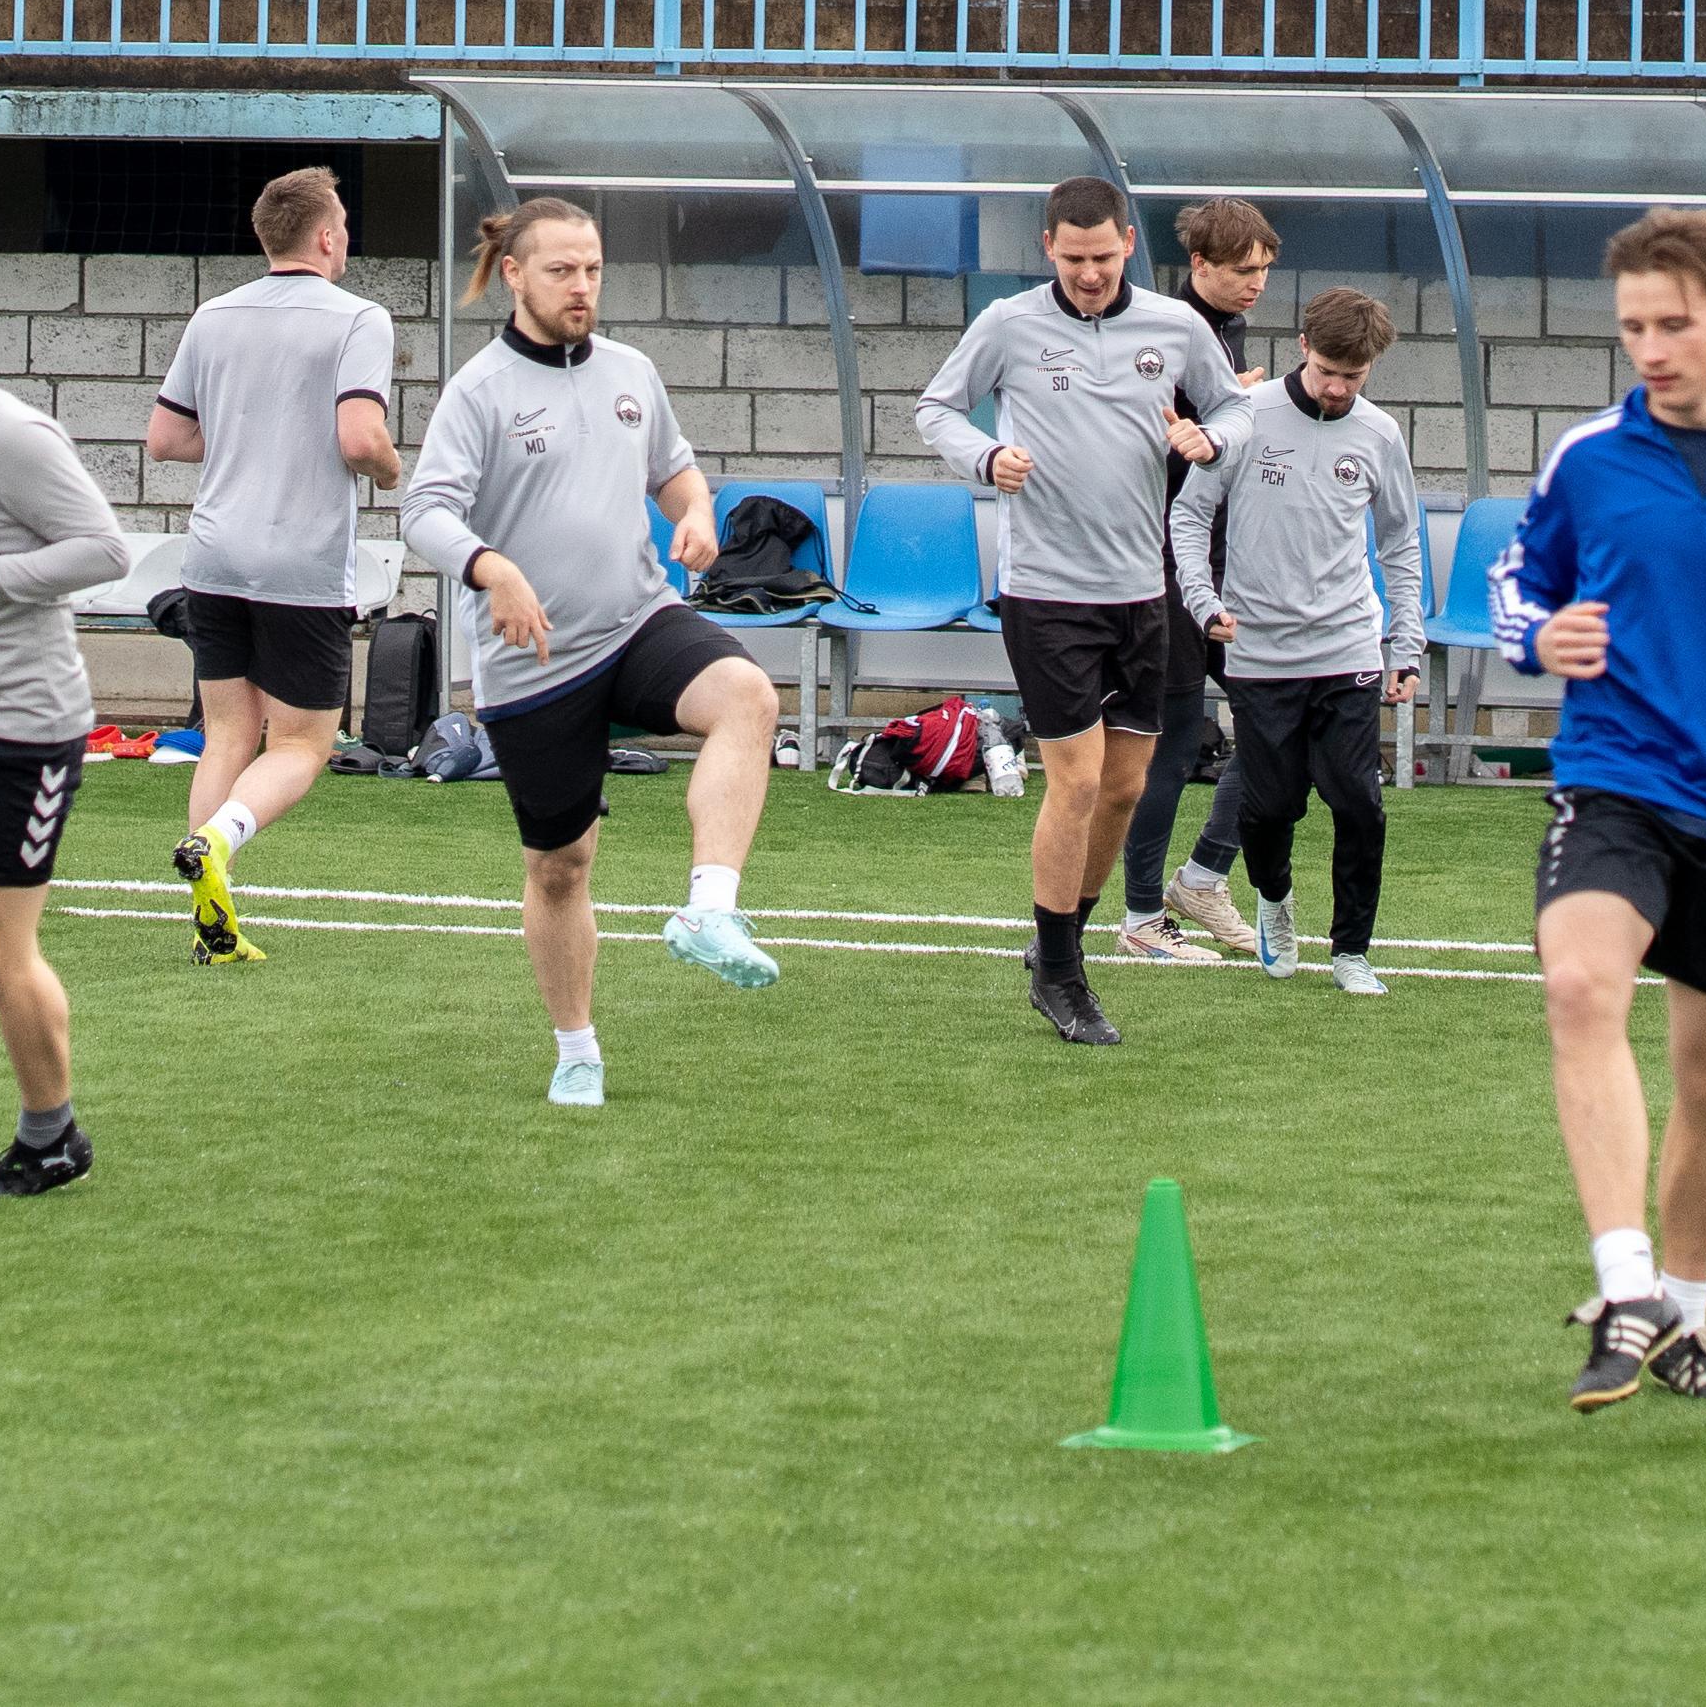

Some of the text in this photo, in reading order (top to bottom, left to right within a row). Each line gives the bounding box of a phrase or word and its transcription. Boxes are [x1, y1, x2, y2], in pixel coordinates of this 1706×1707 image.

[1053, 376, 1069, 391] SD
[525, 437, 546, 456] MD
[1262, 469, 1285, 486] PCH
